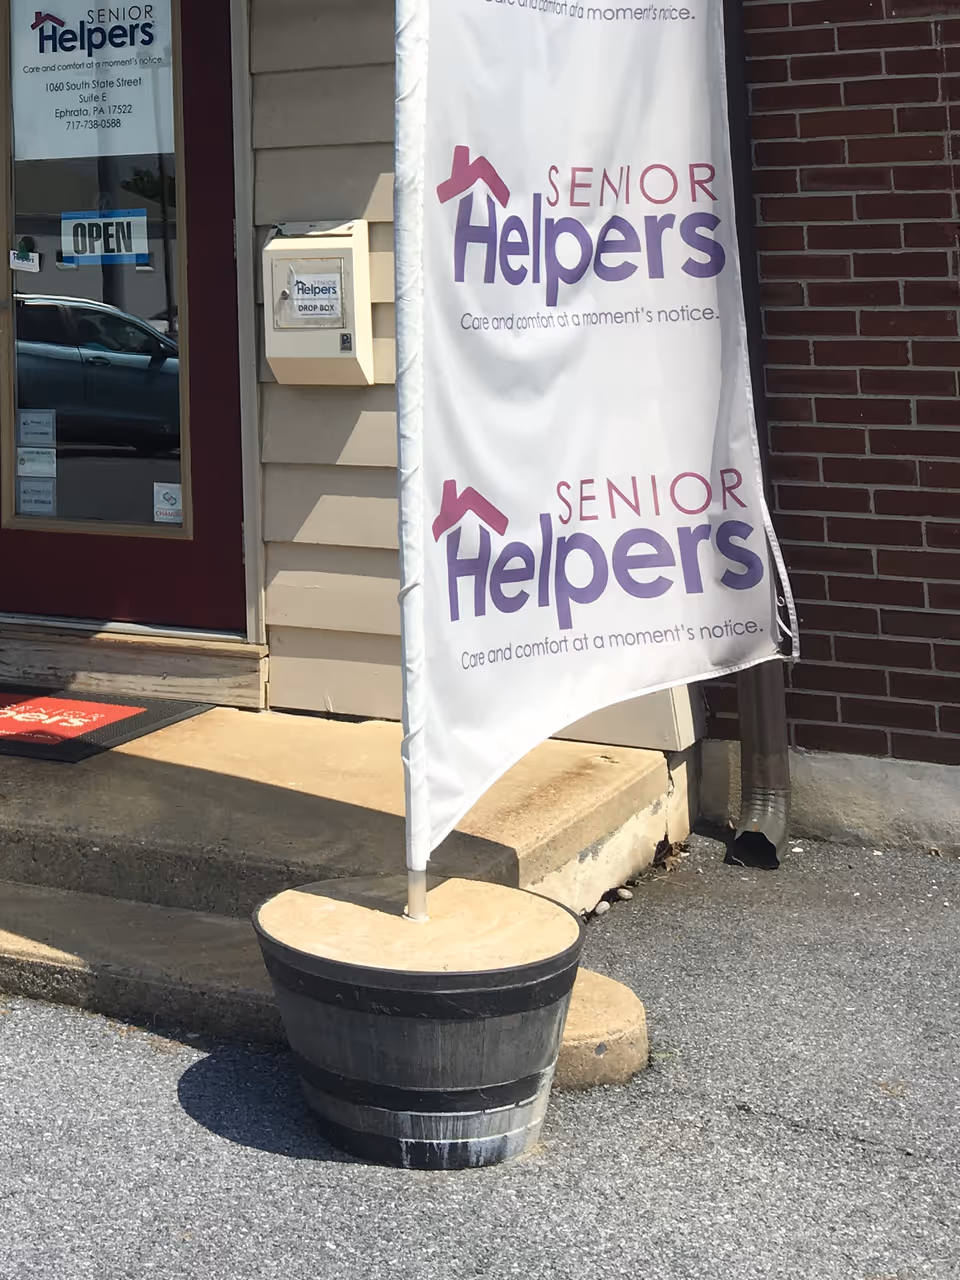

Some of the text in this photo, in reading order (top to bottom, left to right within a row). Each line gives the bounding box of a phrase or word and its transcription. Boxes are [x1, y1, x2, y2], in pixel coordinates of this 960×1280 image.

[87, 5, 153, 24] SENIOR
[39, 21, 154, 57] Helpers
[42, 64, 56, 72] and
[57, 62, 85, 71] comfort
[86, 61, 94, 69] at
[102, 58, 137, 67] moment's
[46, 77, 142, 92] 1060 South State Street
[79, 92, 107, 103] Suite E
[55, 104, 133, 119] Ephrata, PA 17522
[66, 118, 121, 130] 717-738-0588
[546, 163, 718, 207] SENIOR
[73, 221, 133, 255] OPEN
[454, 191, 726, 307] Helpers
[297, 284, 337, 296] Helpers
[298, 304, 335, 312] DROP BOX
[460, 305, 720, 330] Care and comfort at a moment's notice.
[556, 468, 747, 525] SENIOR
[446, 513, 764, 630] Helpers
[461, 619, 764, 669] Care and comfort at a moment's notice.
